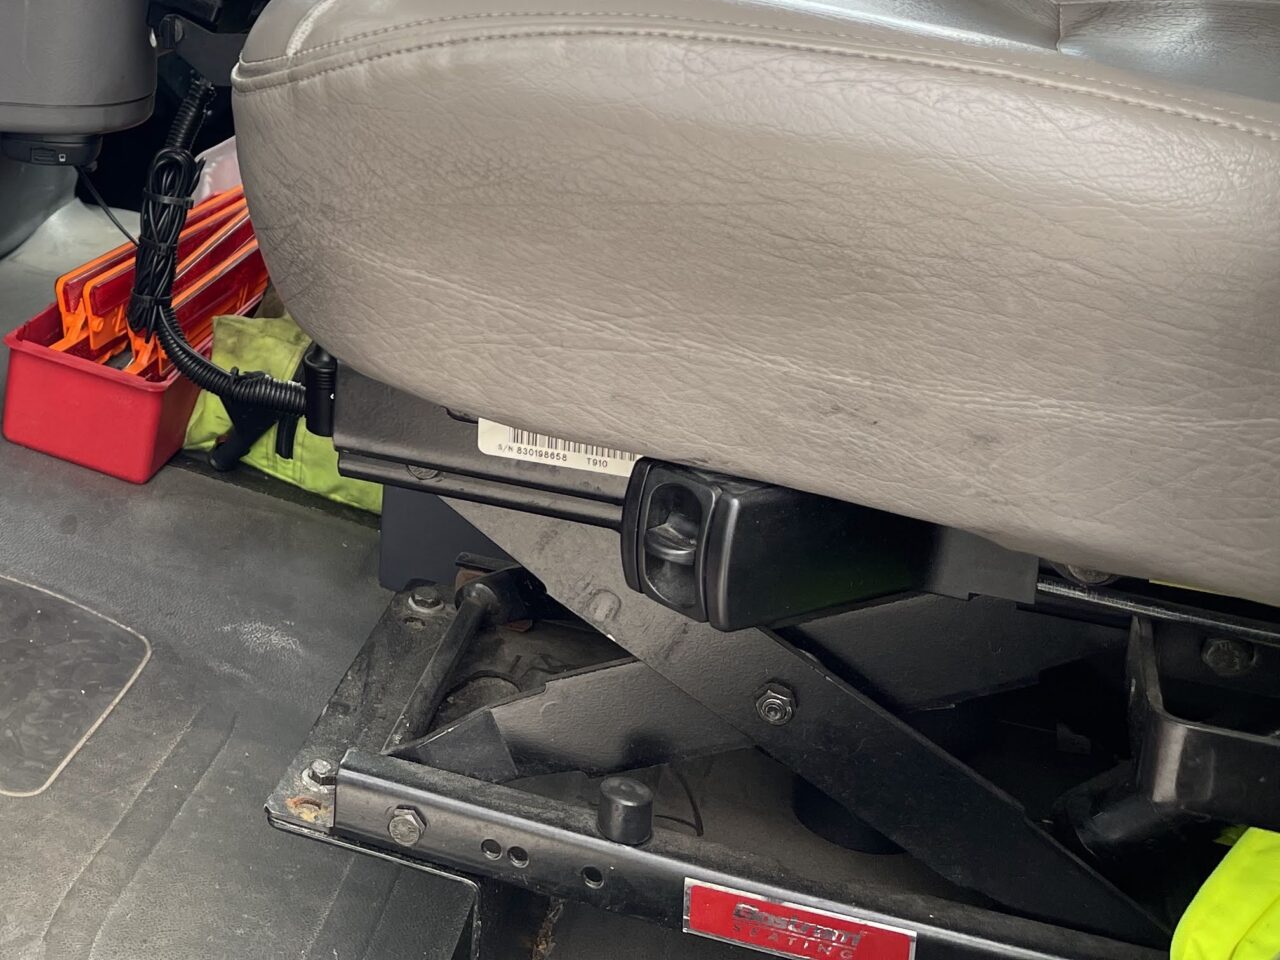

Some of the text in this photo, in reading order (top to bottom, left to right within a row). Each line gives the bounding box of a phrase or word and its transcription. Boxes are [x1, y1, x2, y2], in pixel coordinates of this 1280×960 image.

[497, 443, 514, 453] S/N
[587, 457, 608, 468] T910
[733, 924, 854, 959] SEATING
